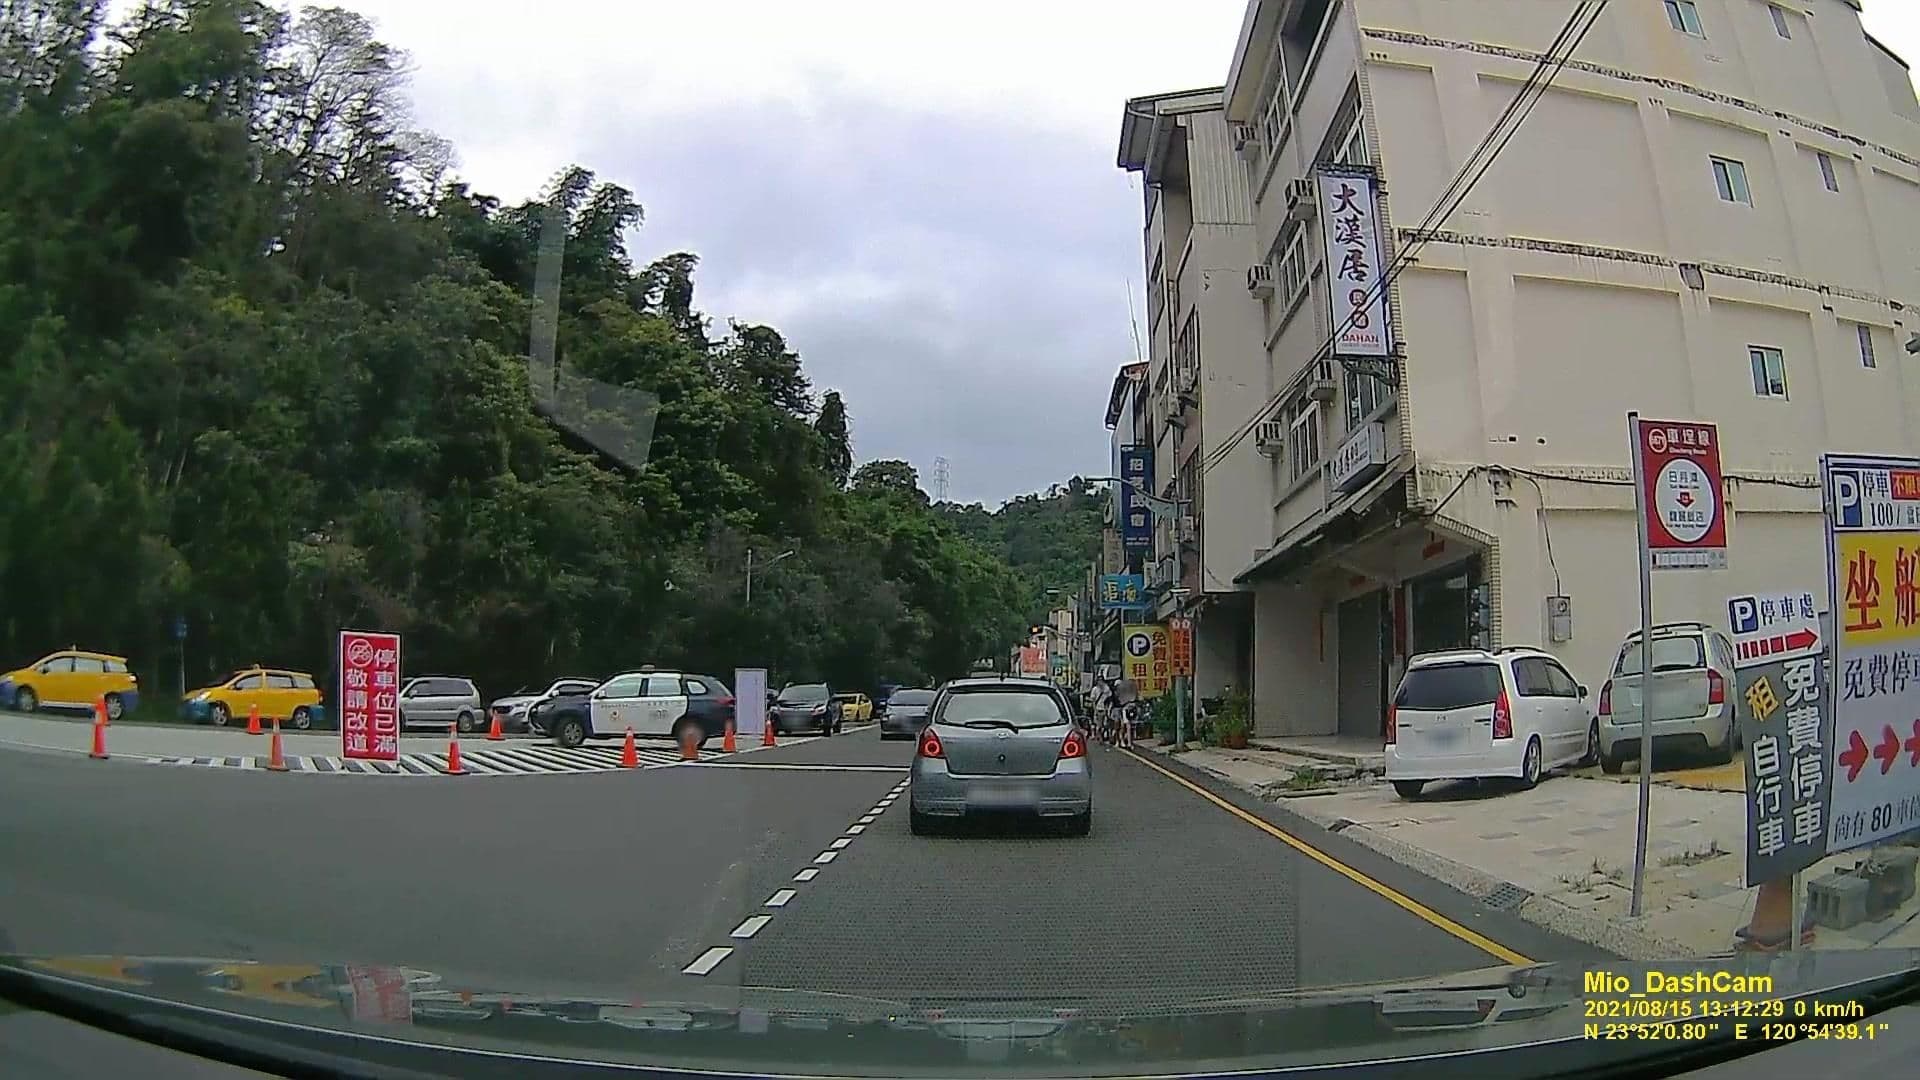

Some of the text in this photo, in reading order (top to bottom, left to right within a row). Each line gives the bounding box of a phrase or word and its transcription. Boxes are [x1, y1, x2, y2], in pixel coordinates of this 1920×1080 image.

[1331, 182, 1370, 283] 大漢居
[1342, 333, 1379, 343] DAHAN
[1862, 470, 1920, 498] 停車 不限
[1760, 592, 1815, 627] 停車處
[1844, 546, 1920, 633] 坐船
[1152, 631, 1169, 691] 免費停車
[346, 667, 369, 753] 敬請改道
[374, 648, 396, 753] 停車位已滿
[1744, 675, 1780, 722] 租
[1783, 656, 1823, 846] 免費停車
[1752, 734, 1786, 857] 自行車
[1871, 802, 1892, 833] 80
